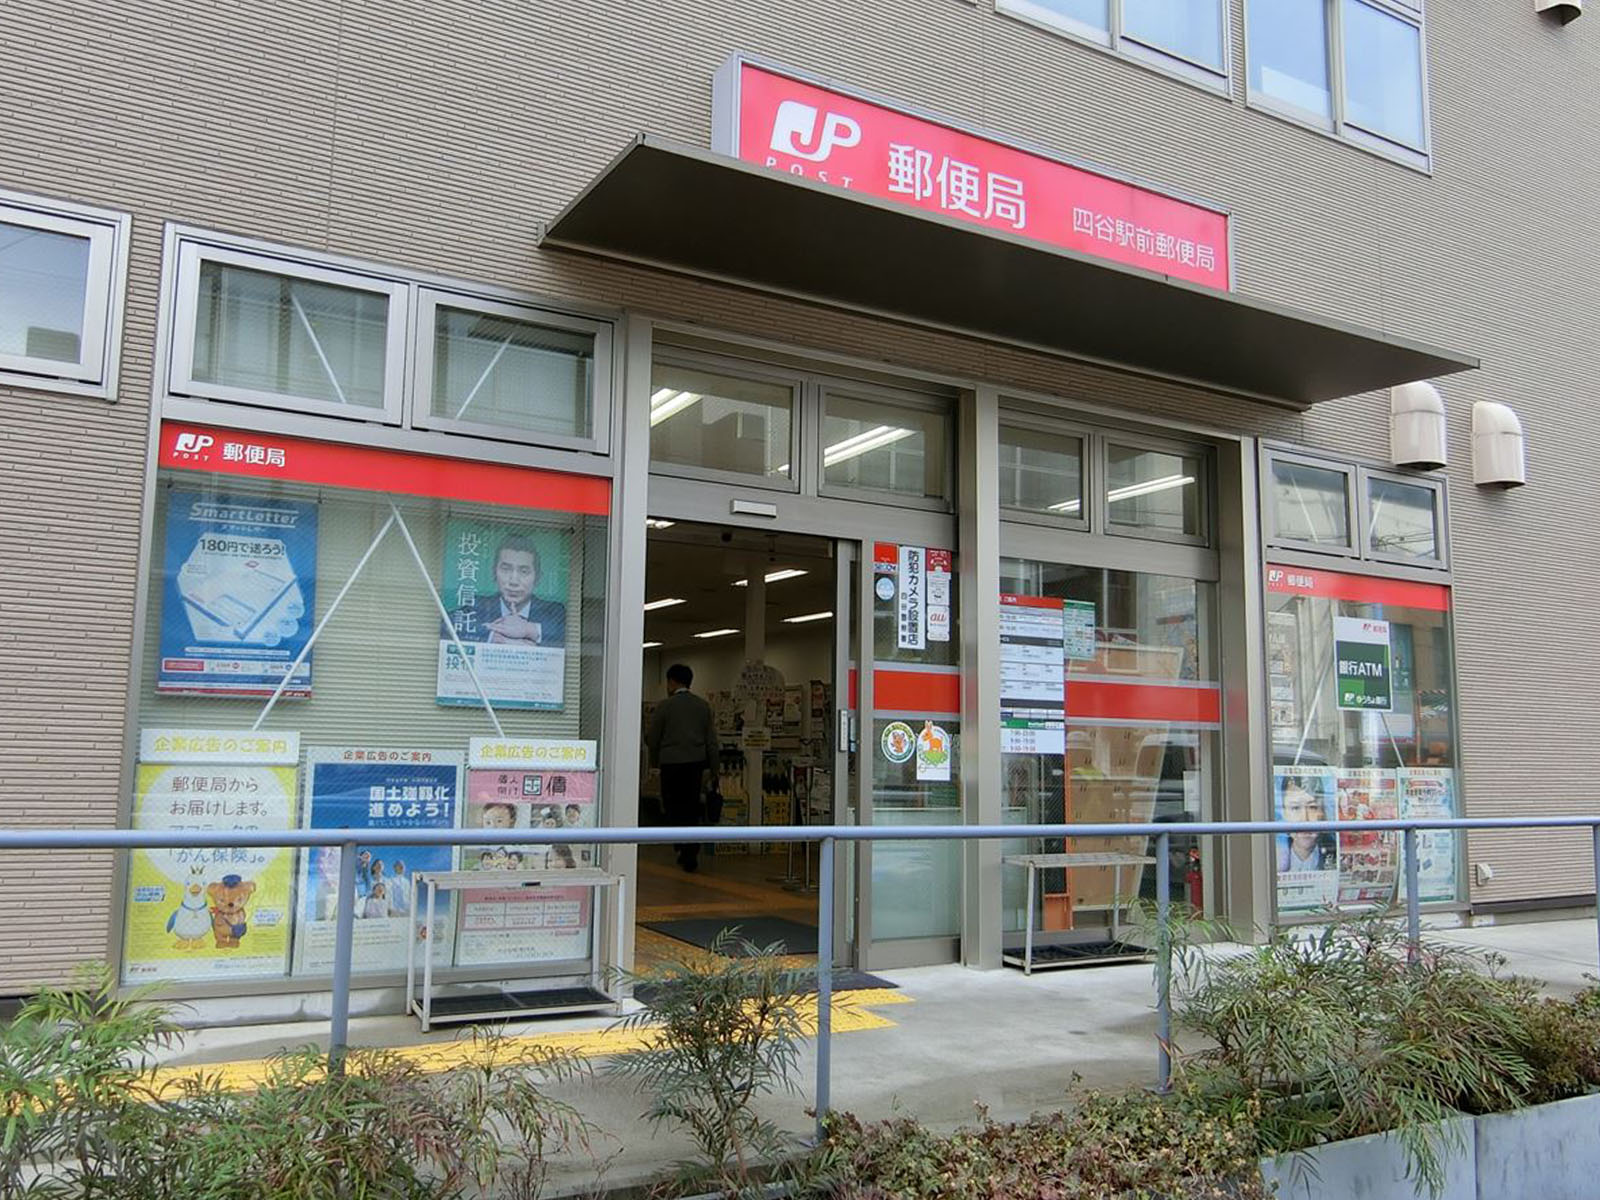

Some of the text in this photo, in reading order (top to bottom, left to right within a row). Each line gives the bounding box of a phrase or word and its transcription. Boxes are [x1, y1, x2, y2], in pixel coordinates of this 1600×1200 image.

[769, 100, 1026, 229] JP 郵便局
[1073, 207, 1215, 272] 四谷駅前郵便局
[172, 452, 209, 461] POST
[175, 433, 286, 467] JP 郵便局
[190, 502, 299, 526] SmartLetter
[454, 532, 481, 634] 投資信託
[908, 550, 919, 646] 防犯カメラ設置店
[1339, 660, 1383, 677] 銀行ATM
[154, 736, 288, 753] 企業広告のご案内
[481, 744, 587, 760] 企業広告のご案内
[343, 751, 433, 762] 企業広告のご案内
[171, 776, 259, 792] 郵便局から
[169, 800, 268, 817] お届けします。
